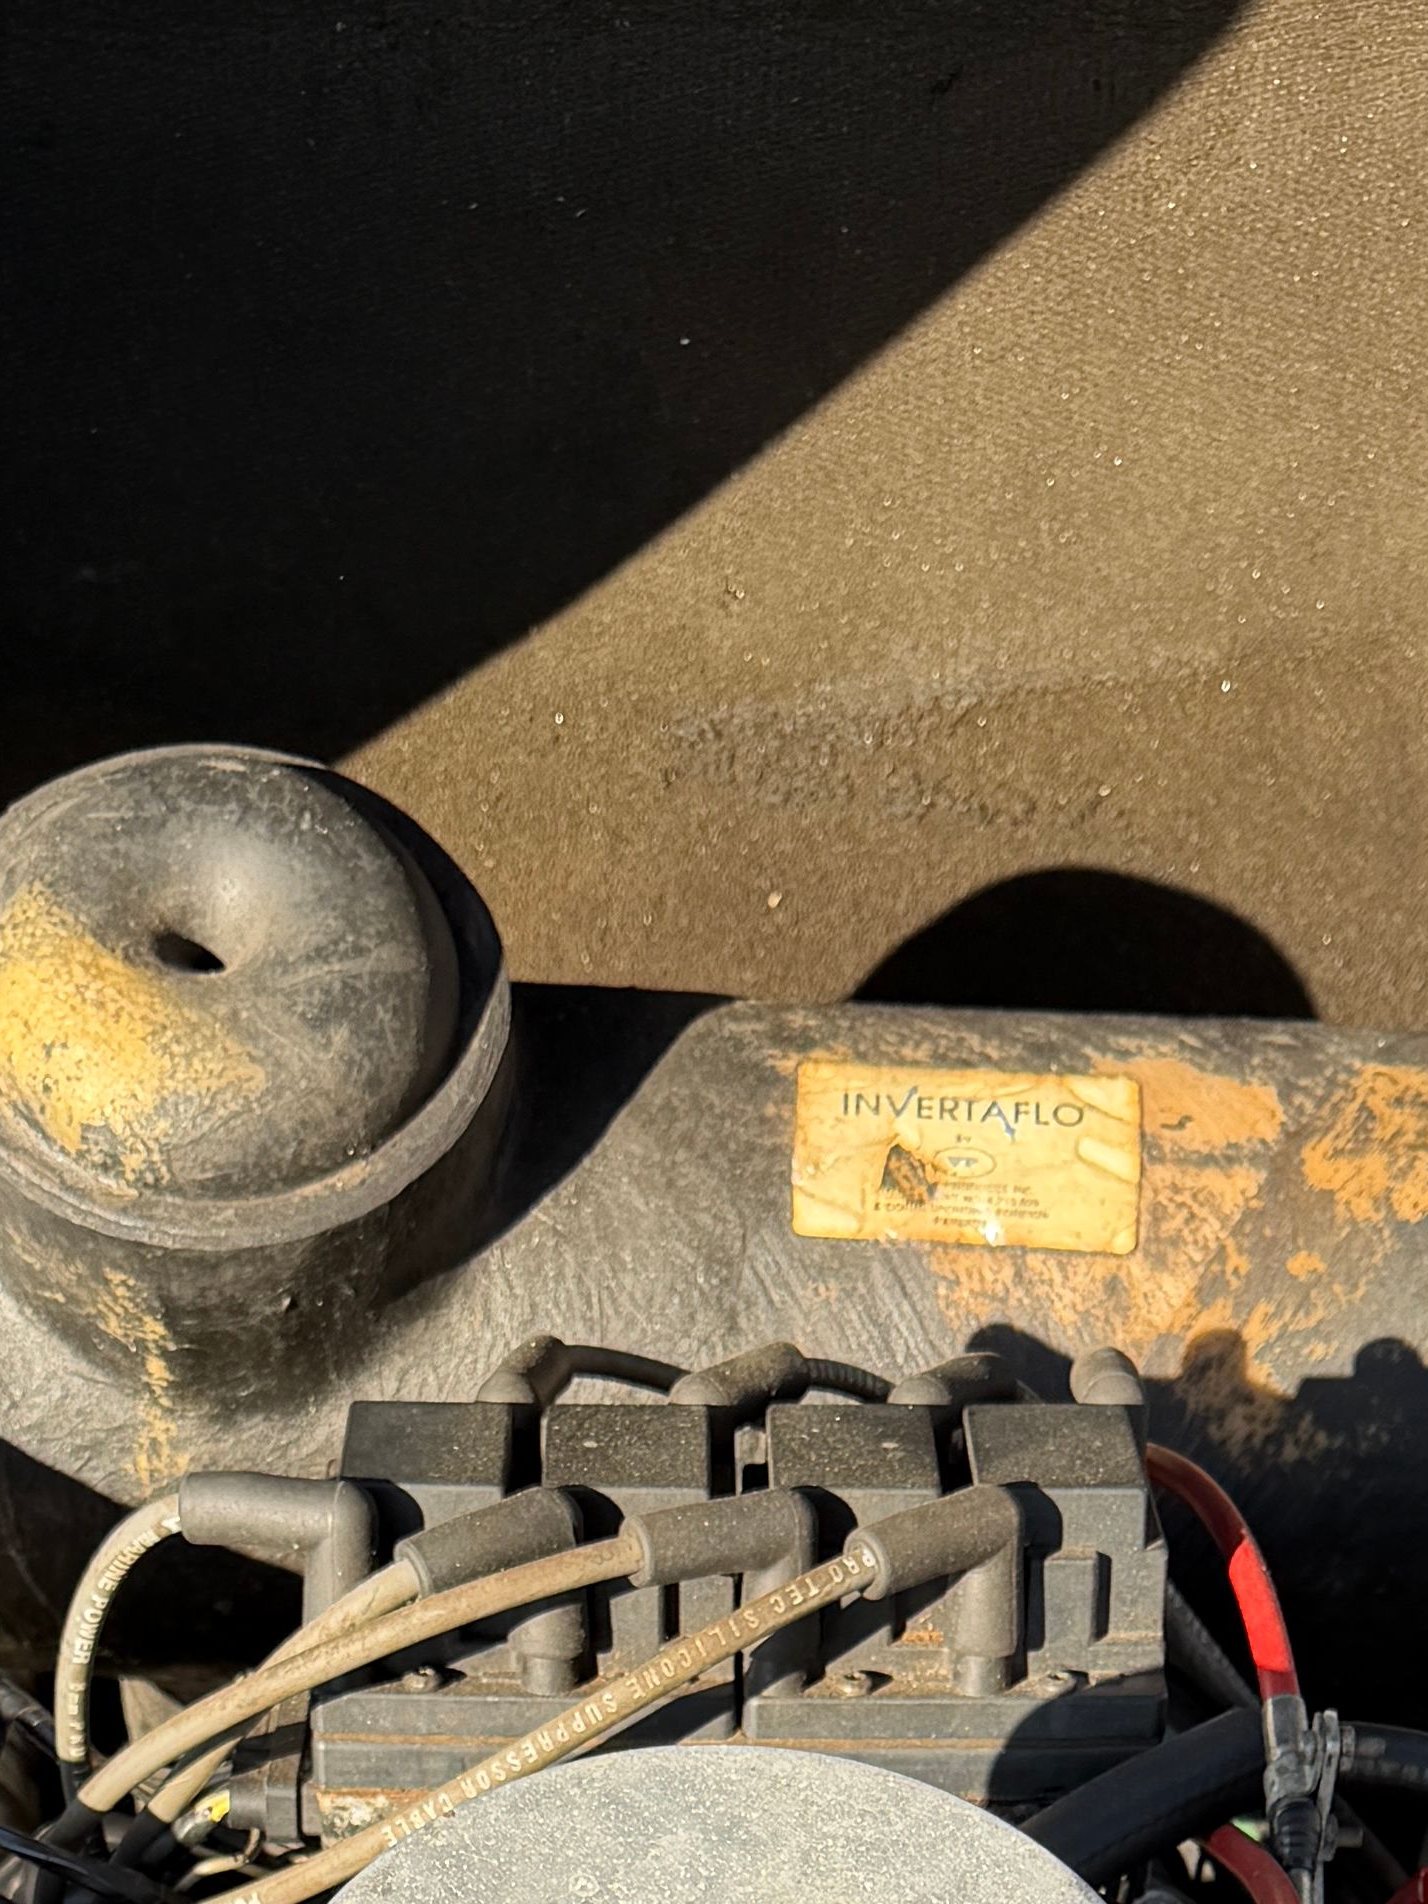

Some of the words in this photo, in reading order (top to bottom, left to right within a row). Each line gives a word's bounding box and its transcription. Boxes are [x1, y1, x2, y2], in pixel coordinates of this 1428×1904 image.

[842, 1086, 1085, 1142] INVERTAFLO
[98, 1528, 161, 1590] MARINE
[767, 1572, 820, 1617] TEC
[72, 1593, 109, 1664] POWER
[622, 1604, 765, 1701] SILICONE
[457, 1692, 622, 1800] SUPPRESSOR
[376, 1789, 456, 1848] CABLE
